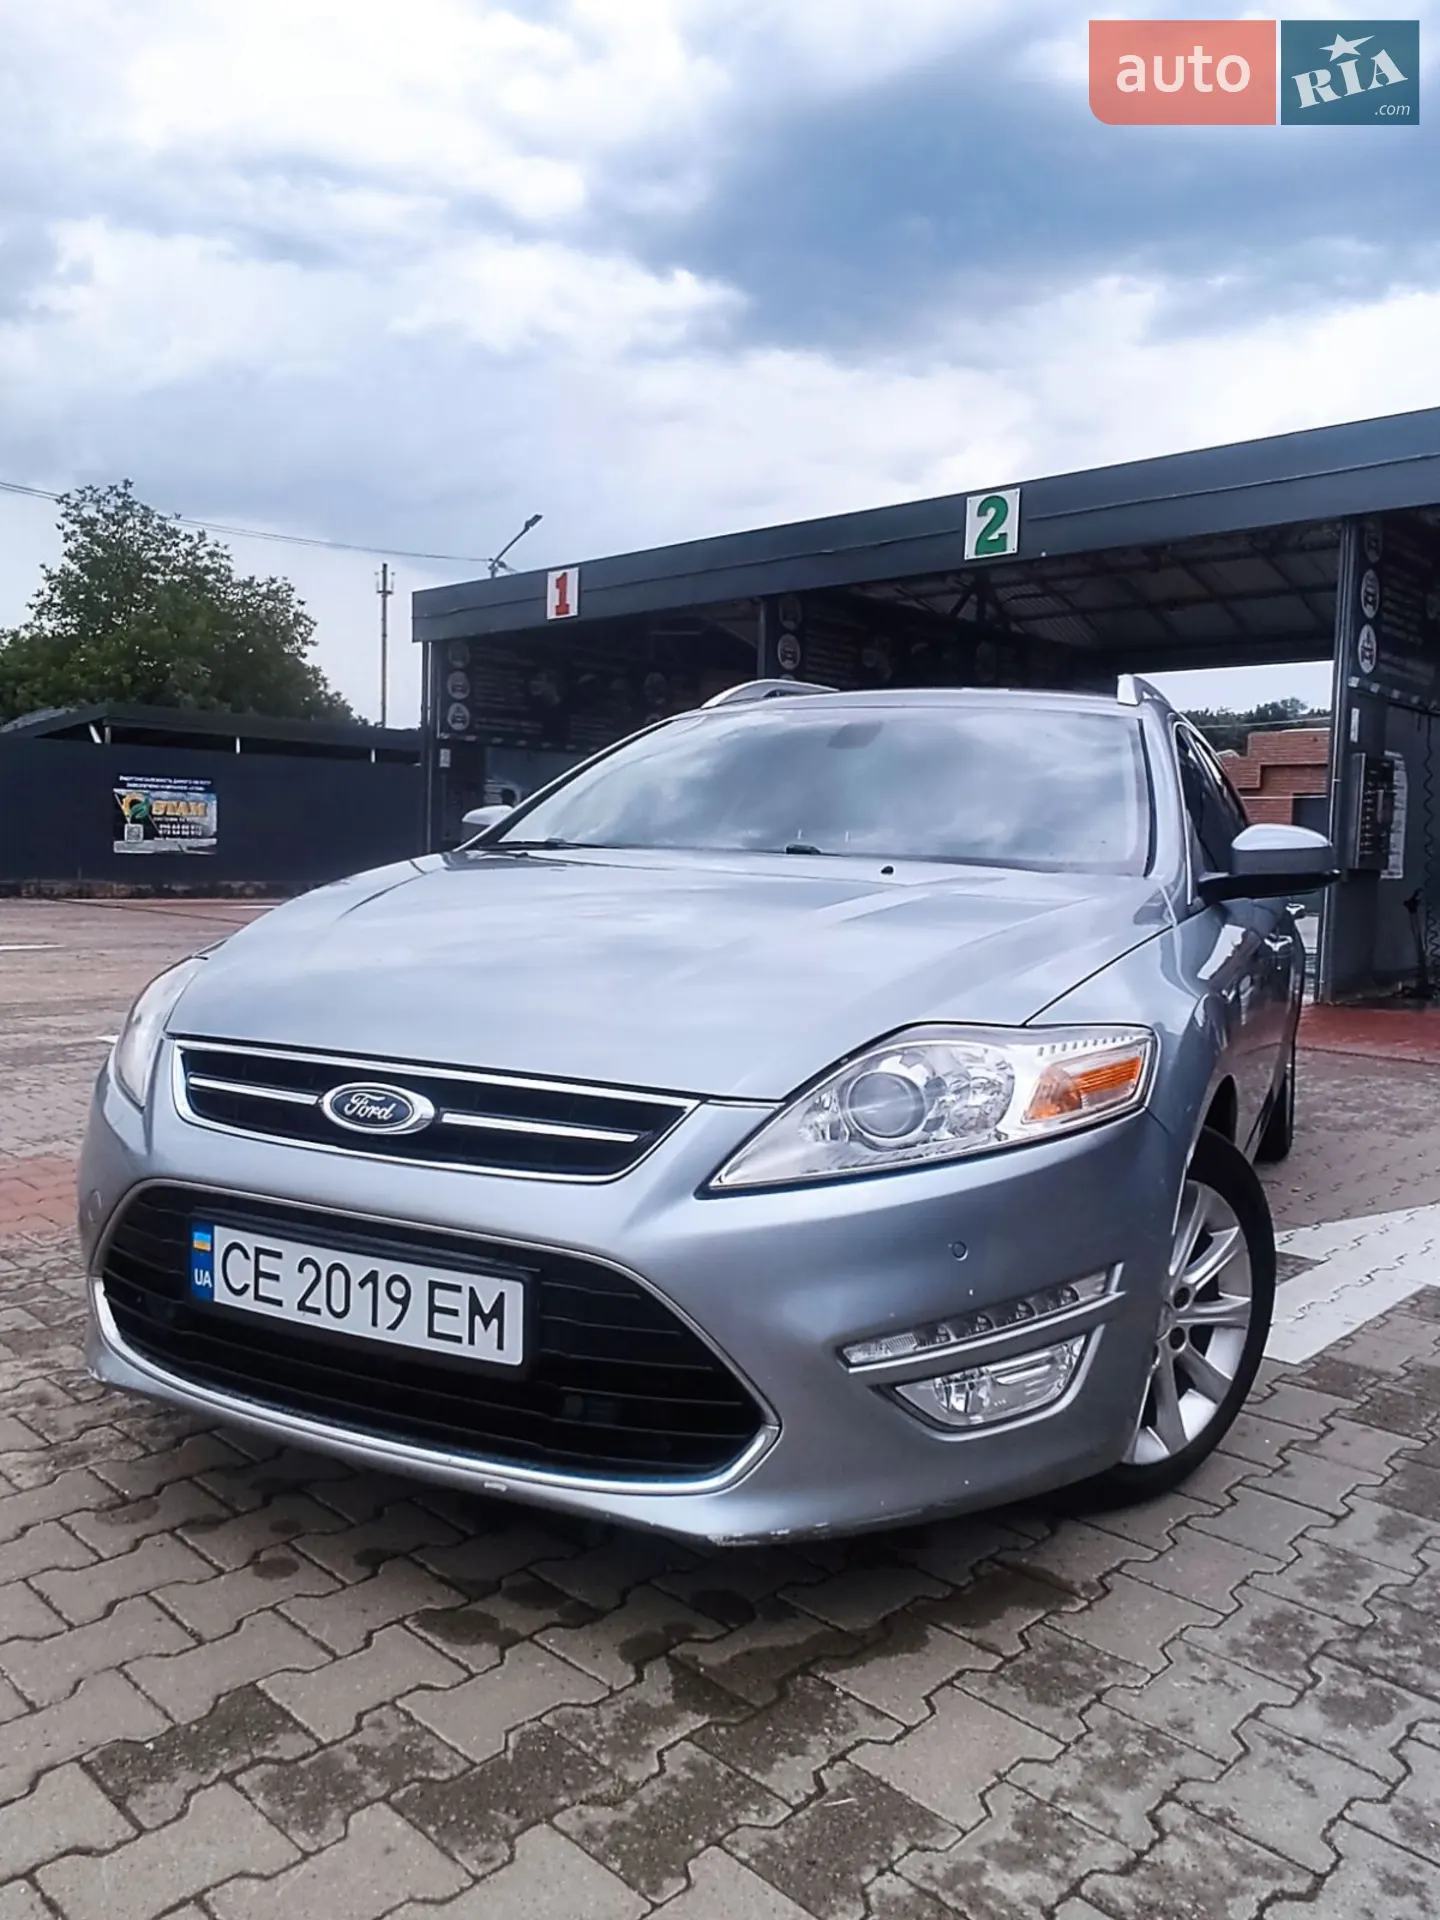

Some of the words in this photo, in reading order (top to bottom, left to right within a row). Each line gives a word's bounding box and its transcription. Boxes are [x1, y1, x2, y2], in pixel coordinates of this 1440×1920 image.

[974, 494, 1009, 557] 2
[555, 571, 570, 617] 1
[344, 1092, 396, 1121] Ford
[193, 1268, 213, 1289] UA
[221, 1241, 284, 1308] CE
[296, 1256, 412, 1332] 2019
[427, 1279, 506, 1351] EM
